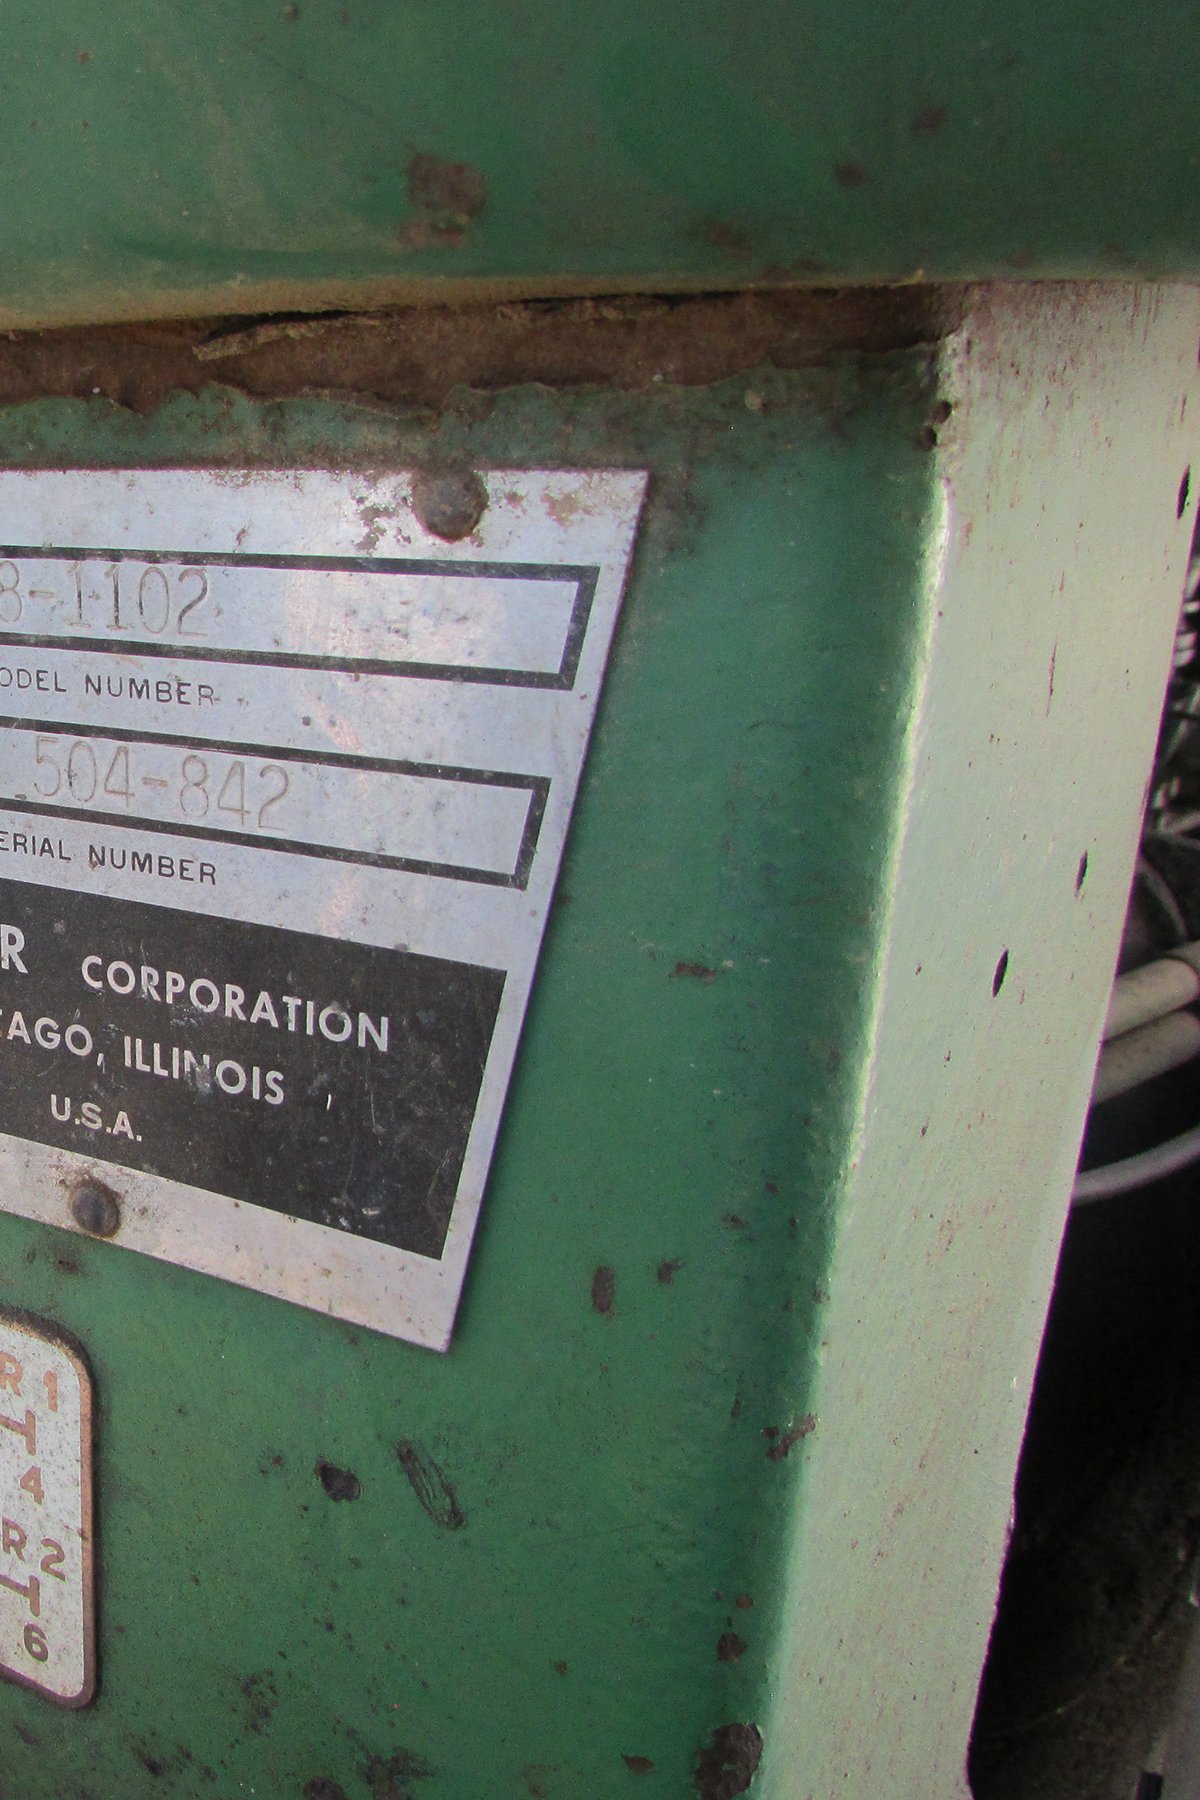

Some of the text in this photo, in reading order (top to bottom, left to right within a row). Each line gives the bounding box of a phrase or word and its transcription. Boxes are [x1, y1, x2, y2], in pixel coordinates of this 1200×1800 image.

[85, 673, 216, 706] NUMBER
[32, 734, 290, 832] 504-842
[89, 844, 217, 886] NUMBER
[81, 955, 389, 1052] CORPORATION
[123, 1035, 285, 1105] ILLINOIS
[50, 1093, 143, 1142] U.S.A.
[19, 1464, 45, 1505] 4
[23, 1622, 49, 1662] 6
